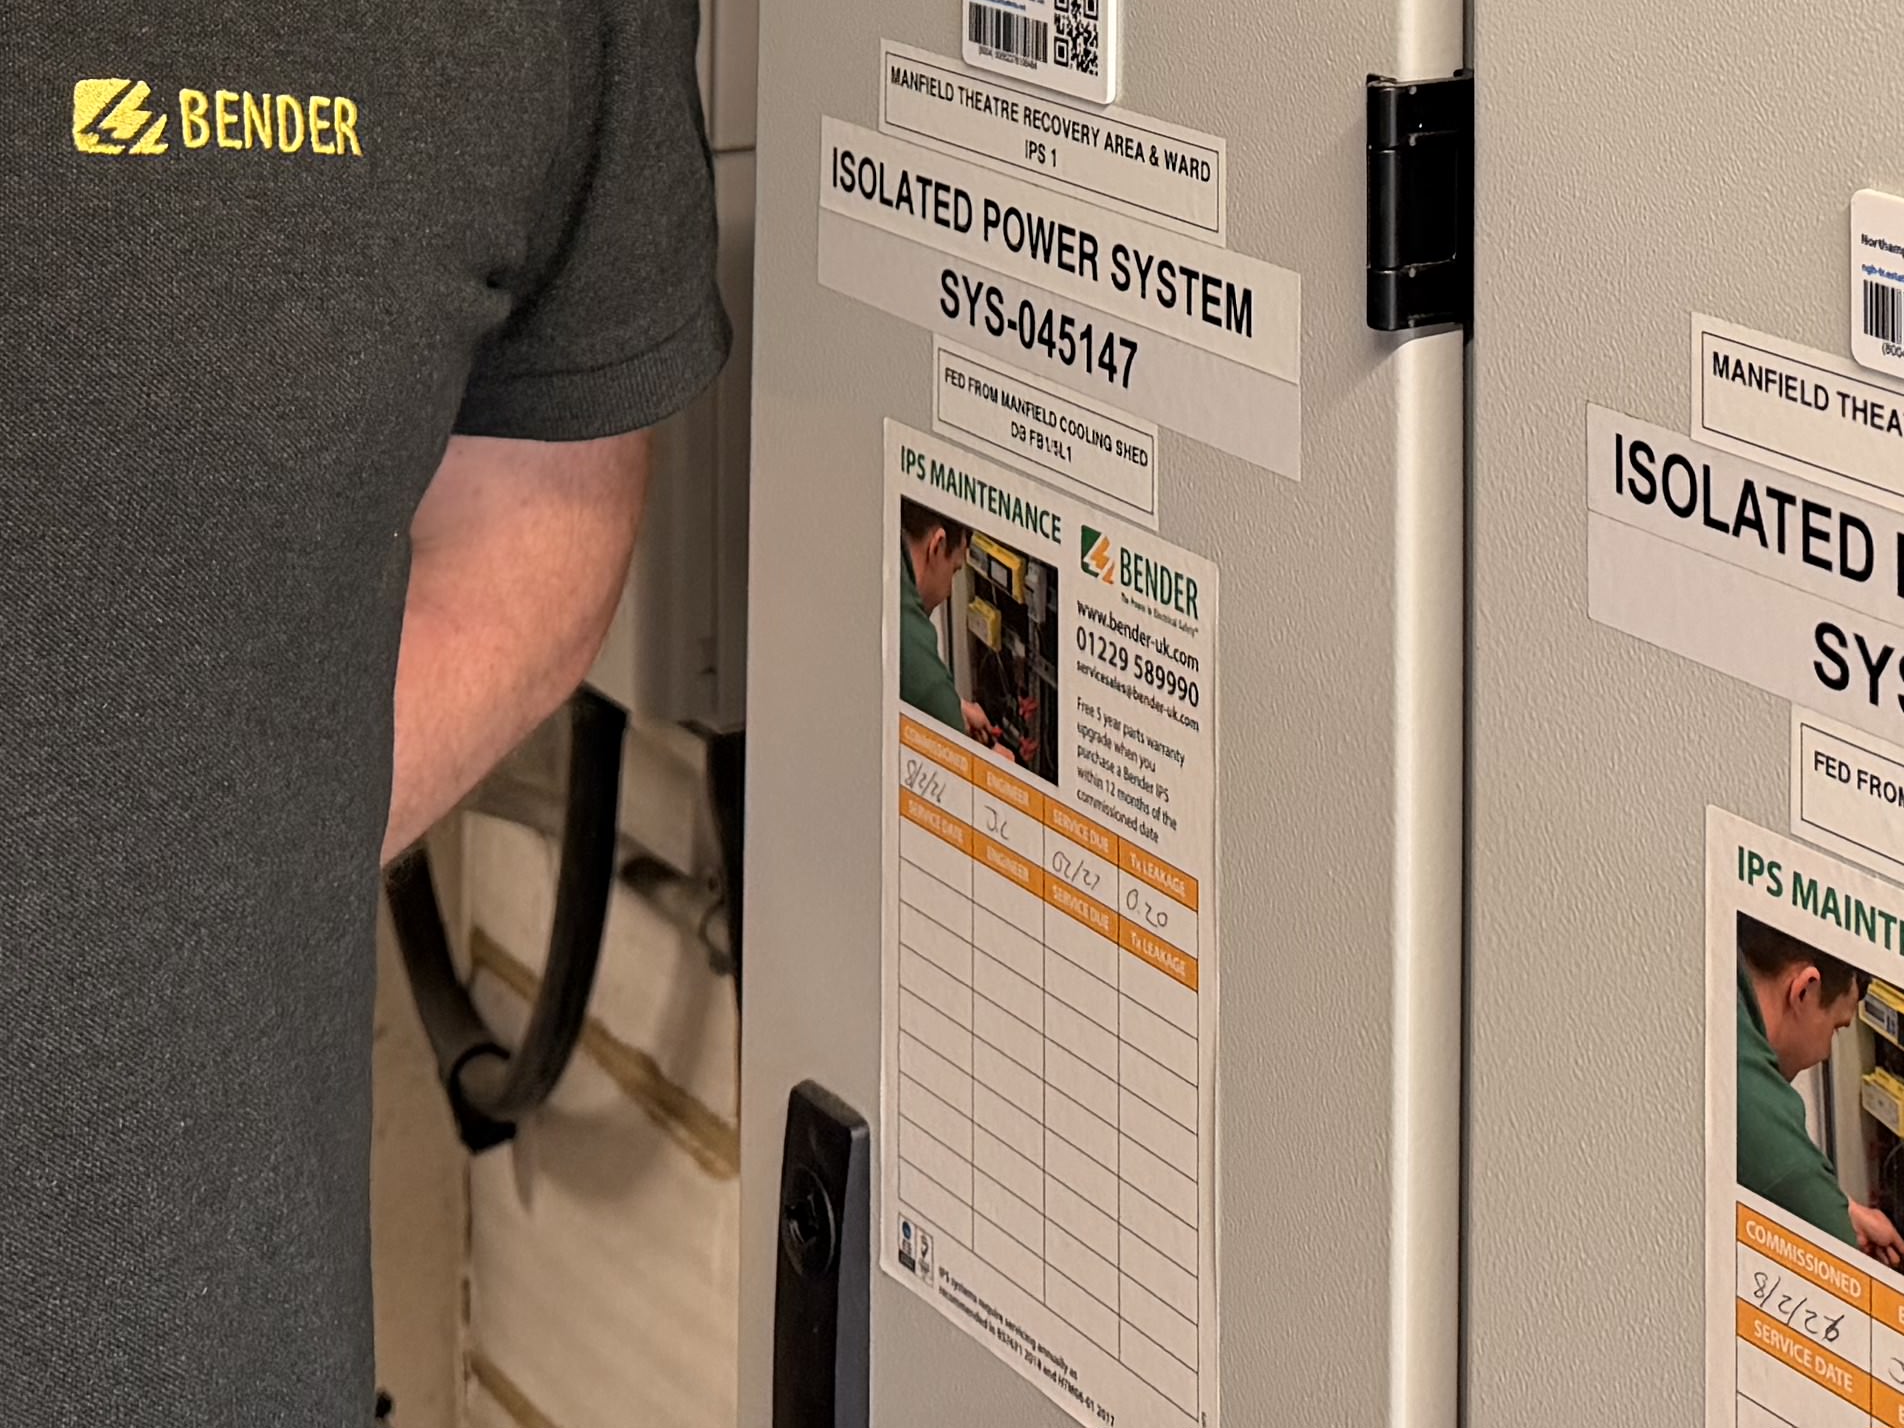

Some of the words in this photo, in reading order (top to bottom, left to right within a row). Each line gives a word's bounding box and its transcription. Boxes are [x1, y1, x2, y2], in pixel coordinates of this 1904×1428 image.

[179, 88, 364, 156] BENDER
[890, 65, 954, 102] MANFIELD
[958, 86, 1019, 123] THEATRE
[1024, 106, 1100, 148] RECOVERY
[1104, 131, 1145, 163] AREA
[1149, 145, 1159, 167] &
[1164, 149, 1211, 183] WARD
[1024, 139, 1046, 165] IPS
[1050, 148, 1057, 168] 1
[832, 146, 972, 235] ISOLATED
[983, 198, 1099, 282] POWER
[1111, 244, 1253, 339] SYSTEM
[939, 268, 1139, 390] SYS-045147
[944, 367, 966, 391] FED
[968, 375, 999, 404] FROM
[1001, 389, 1057, 430] MANFIELD
[1059, 414, 1113, 453] COOLING
[1116, 438, 1149, 468] SHED
[1712, 351, 1830, 411] MANFIELD
[900, 444, 926, 482] IPS
[930, 459, 1062, 545] MAINTENANCE
[1615, 433, 1874, 585] ISOLATED
[1120, 546, 1198, 620] BENDER
[1077, 600, 1199, 672] www.bender-uk.com
[1077, 625, 1129, 672] 01229
[1134, 653, 1199, 708] 589990
[1077, 696, 1095, 718] Free
[1123, 724, 1144, 745] parts
[1146, 738, 1185, 768] warranty
[1814, 751, 1851, 784] FED
[1737, 845, 1783, 897] IPS
[1746, 1220, 1862, 1299] COMMISSIONED
[1754, 1319, 1813, 1369] SERVICE
[1815, 1360, 1854, 1394] DATE
